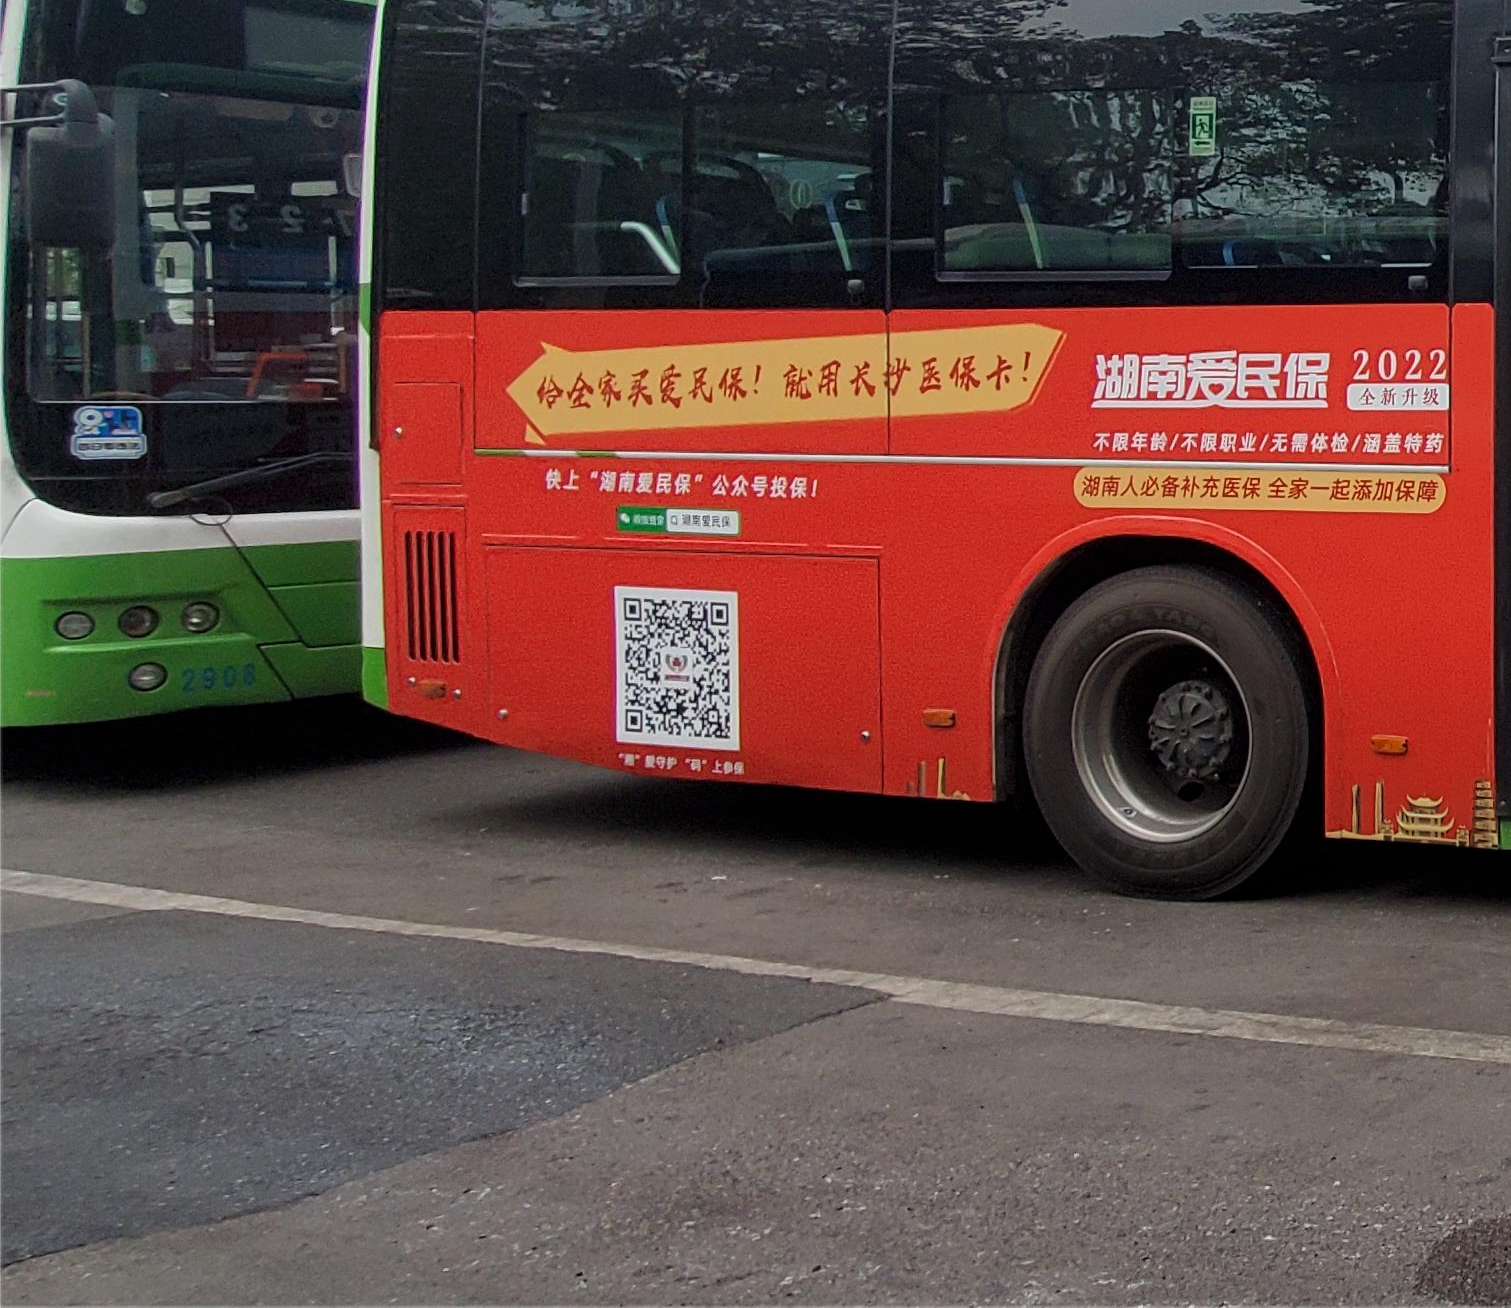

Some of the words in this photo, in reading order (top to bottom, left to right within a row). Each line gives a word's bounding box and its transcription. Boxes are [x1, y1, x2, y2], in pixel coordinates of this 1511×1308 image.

[1090, 349, 1330, 408] 湖南爱民保
[1352, 350, 1448, 381] 2022
[1359, 386, 1441, 408] 全新升级
[1093, 432, 1445, 454] 不限年龄/不限职业/无需体检/涵盖特药
[1081, 475, 1261, 500] 湖南人必备补充医保
[1267, 477, 1440, 503] 全家一起添加保障
